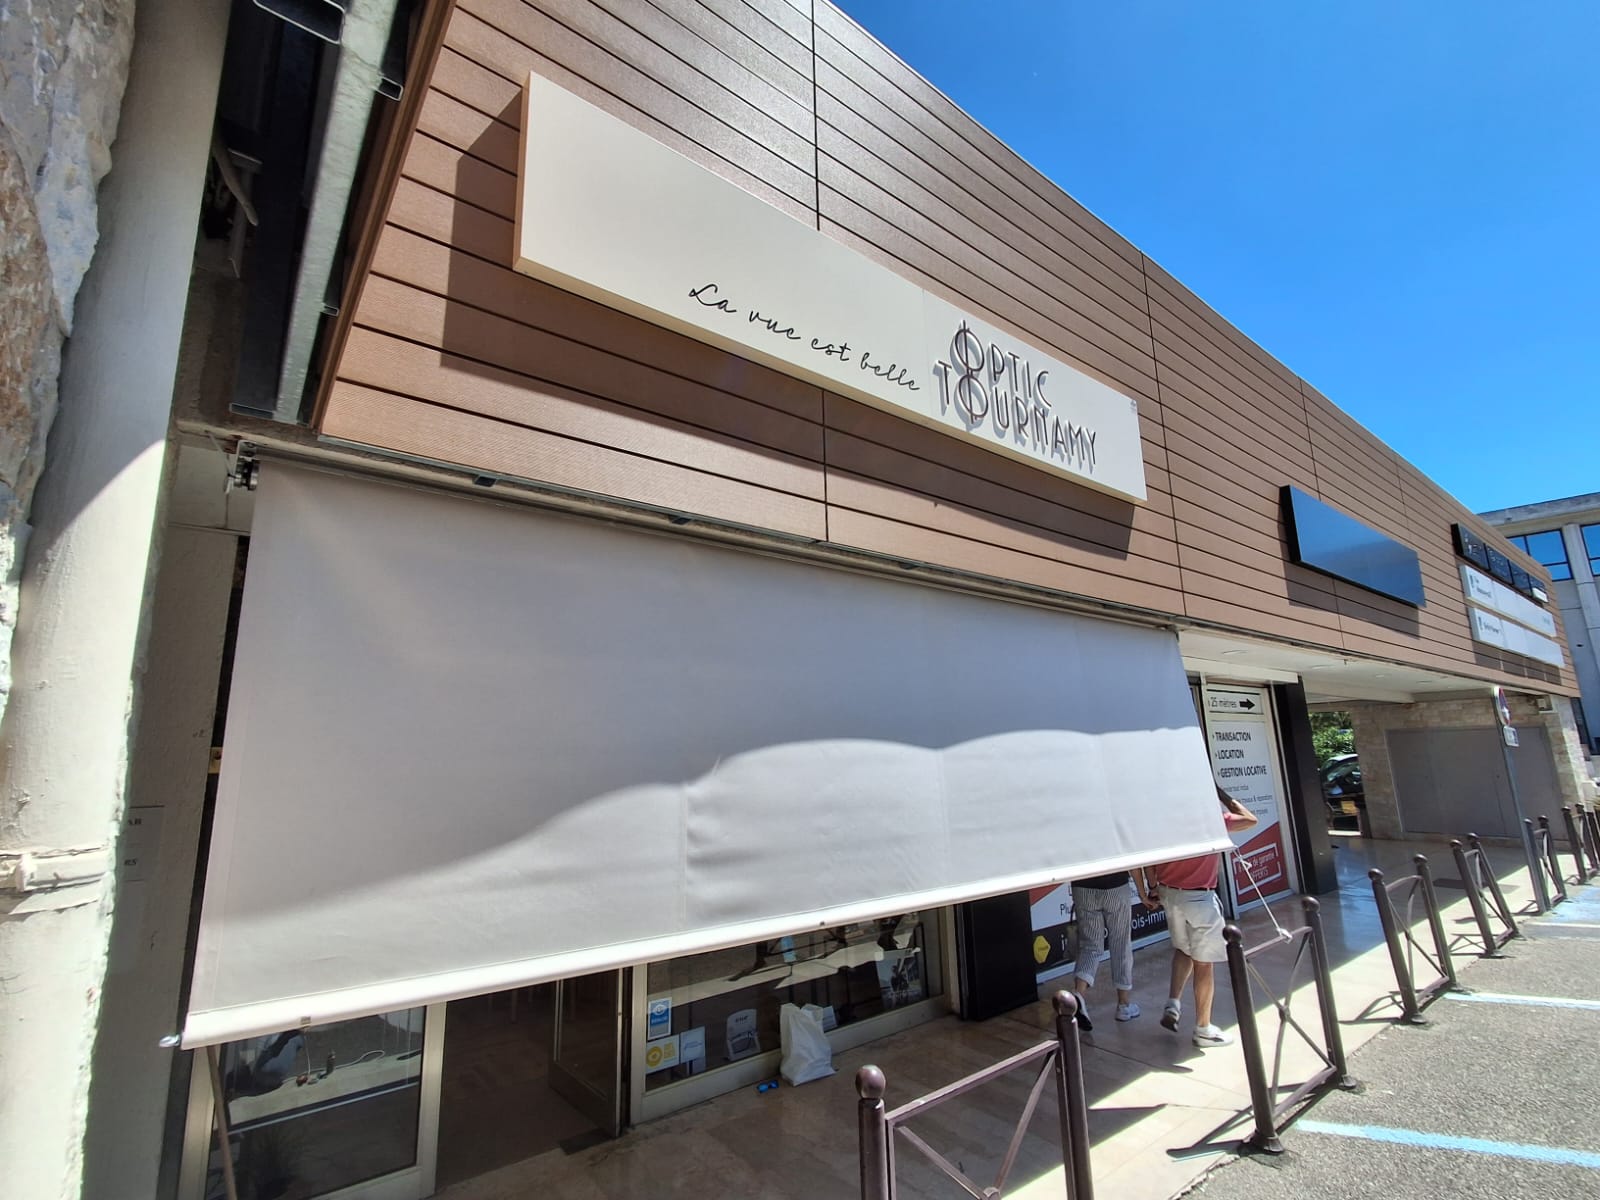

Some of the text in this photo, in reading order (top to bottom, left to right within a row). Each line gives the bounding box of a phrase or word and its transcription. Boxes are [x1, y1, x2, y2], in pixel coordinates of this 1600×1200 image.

[688, 284, 920, 391] La vue est belle
[953, 320, 1052, 408] OPTIC
[936, 360, 1096, 465] TOURNAMY
[1215, 731, 1251, 741] TRANSACTION
[1217, 749, 1244, 759] LOCATION
[1220, 765, 1267, 778] GESTION LOCATIVE
